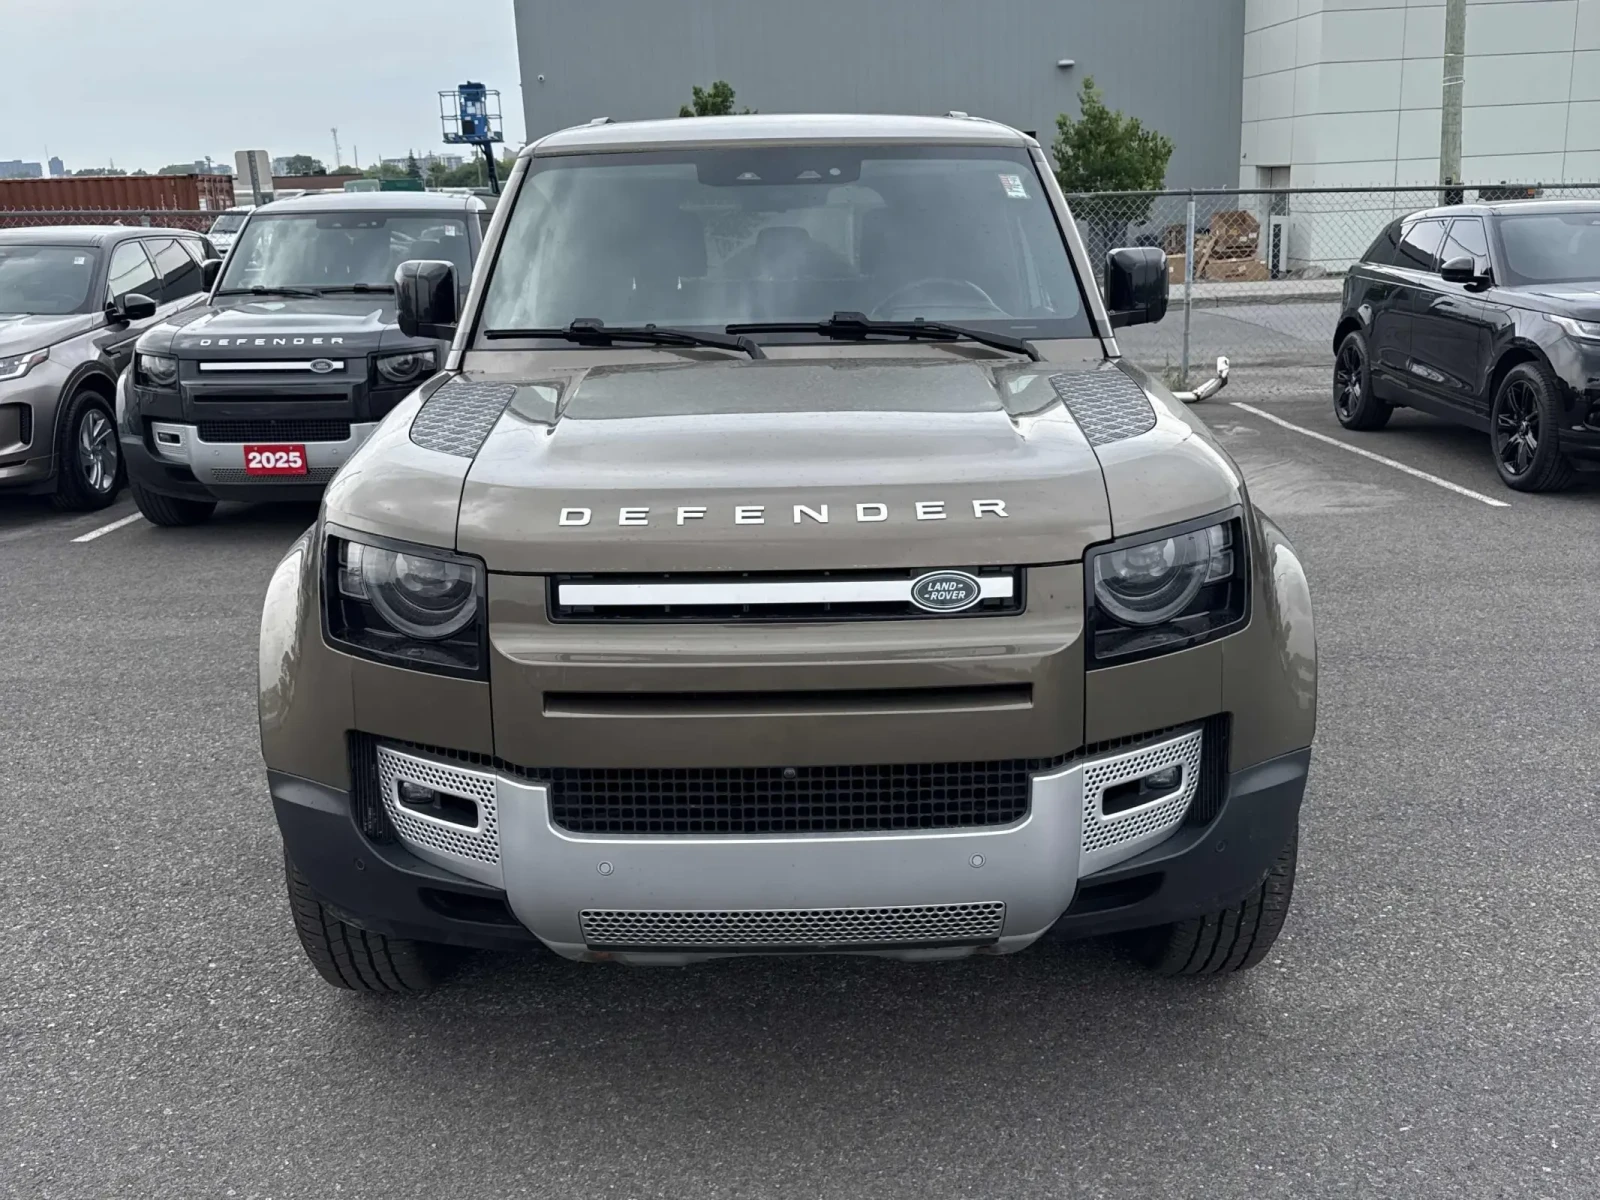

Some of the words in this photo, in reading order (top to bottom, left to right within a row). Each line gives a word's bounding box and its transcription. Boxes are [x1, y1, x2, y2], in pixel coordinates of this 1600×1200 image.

[199, 337, 344, 346] DEFENDER
[248, 451, 303, 469] 2025
[558, 499, 1010, 526] DEFENDER
